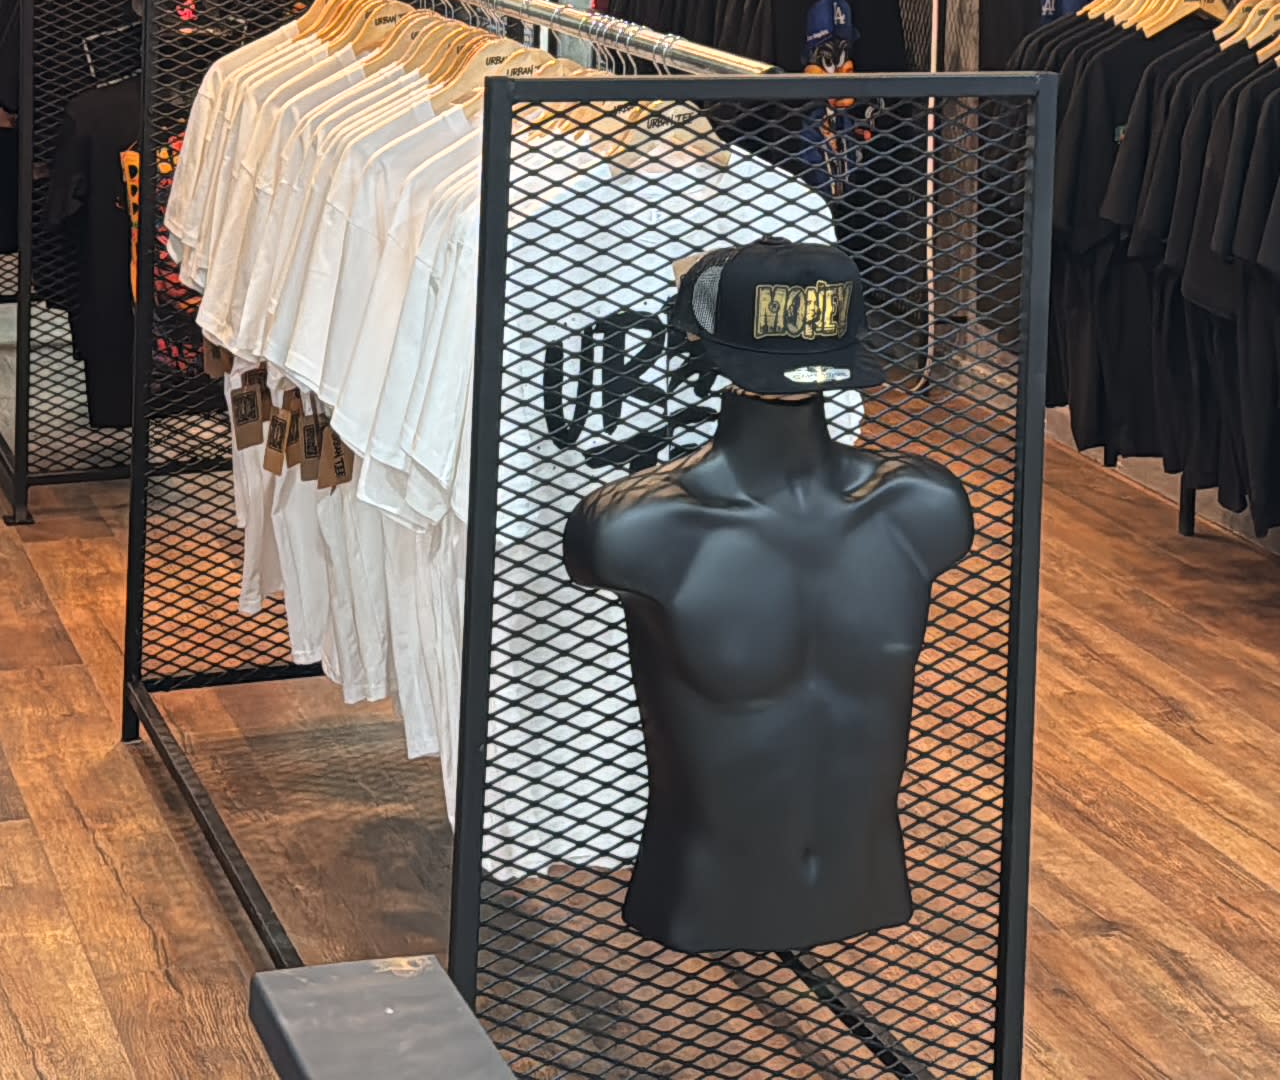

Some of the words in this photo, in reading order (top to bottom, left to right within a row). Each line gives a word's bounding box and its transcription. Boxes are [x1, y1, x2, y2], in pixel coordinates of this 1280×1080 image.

[832, 1, 847, 25] LA
[753, 280, 853, 340] MONEY
[333, 456, 347, 479] TEE
